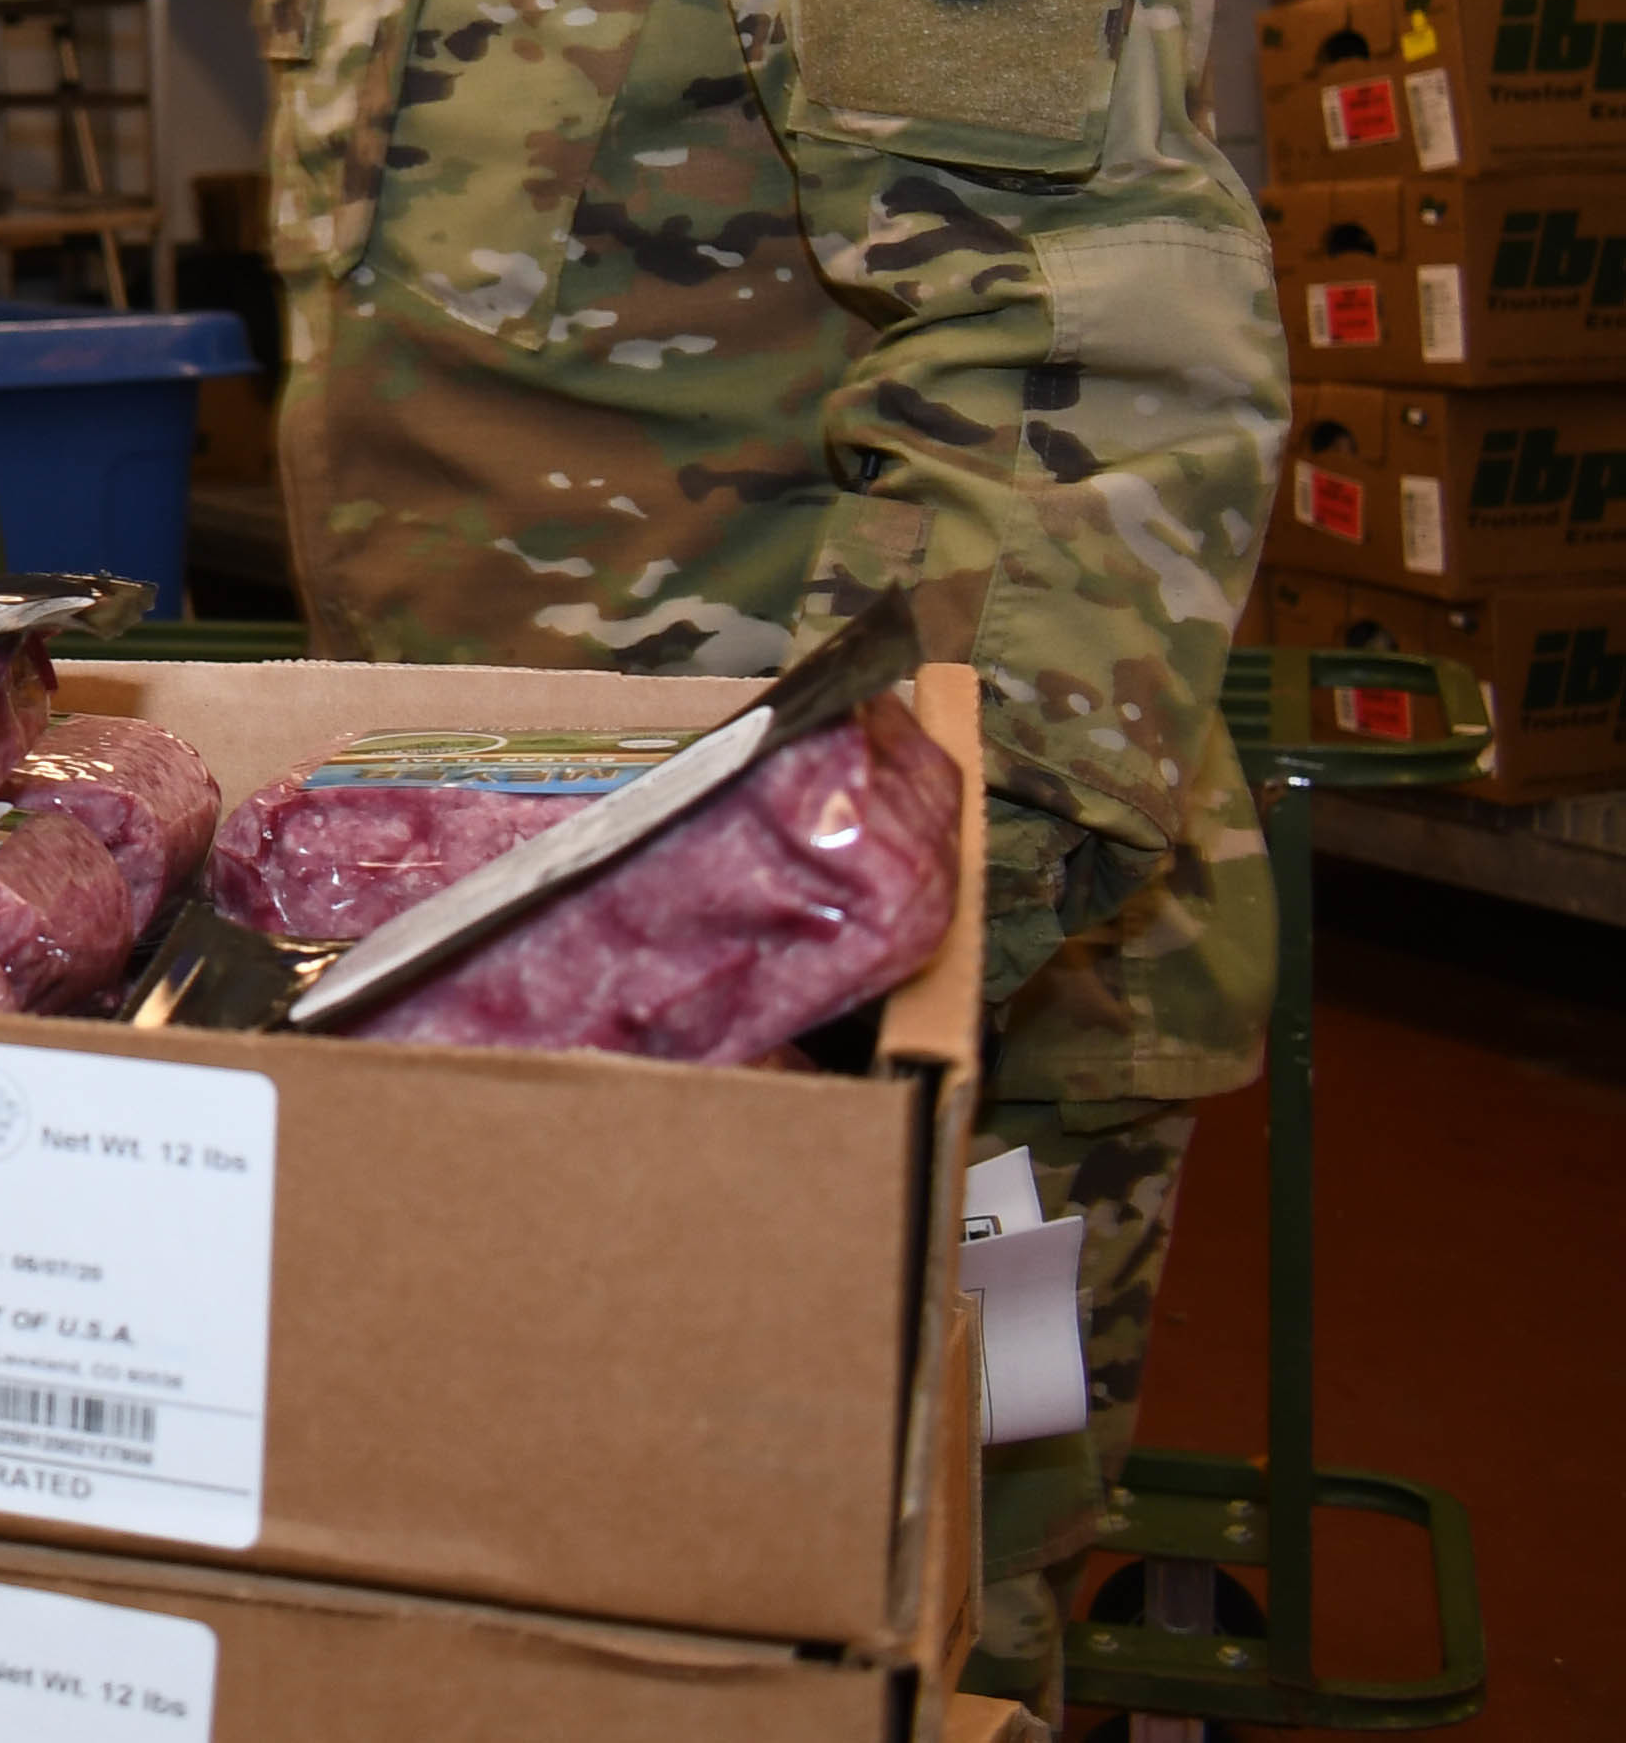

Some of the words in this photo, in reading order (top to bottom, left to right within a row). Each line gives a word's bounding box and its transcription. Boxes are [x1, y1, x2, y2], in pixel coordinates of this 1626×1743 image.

[1488, 83, 1583, 105] Trusted
[1470, 426, 1626, 524] ibp
[356, 764, 622, 784] MEYER
[41, 1125, 91, 1154] Net
[100, 1133, 145, 1161] Wt.
[159, 1141, 193, 1169] 12
[201, 1147, 249, 1174] lbs
[11, 1308, 49, 1332] OF
[101, 1681, 135, 1707] 12
[142, 1689, 190, 1718] lbs
